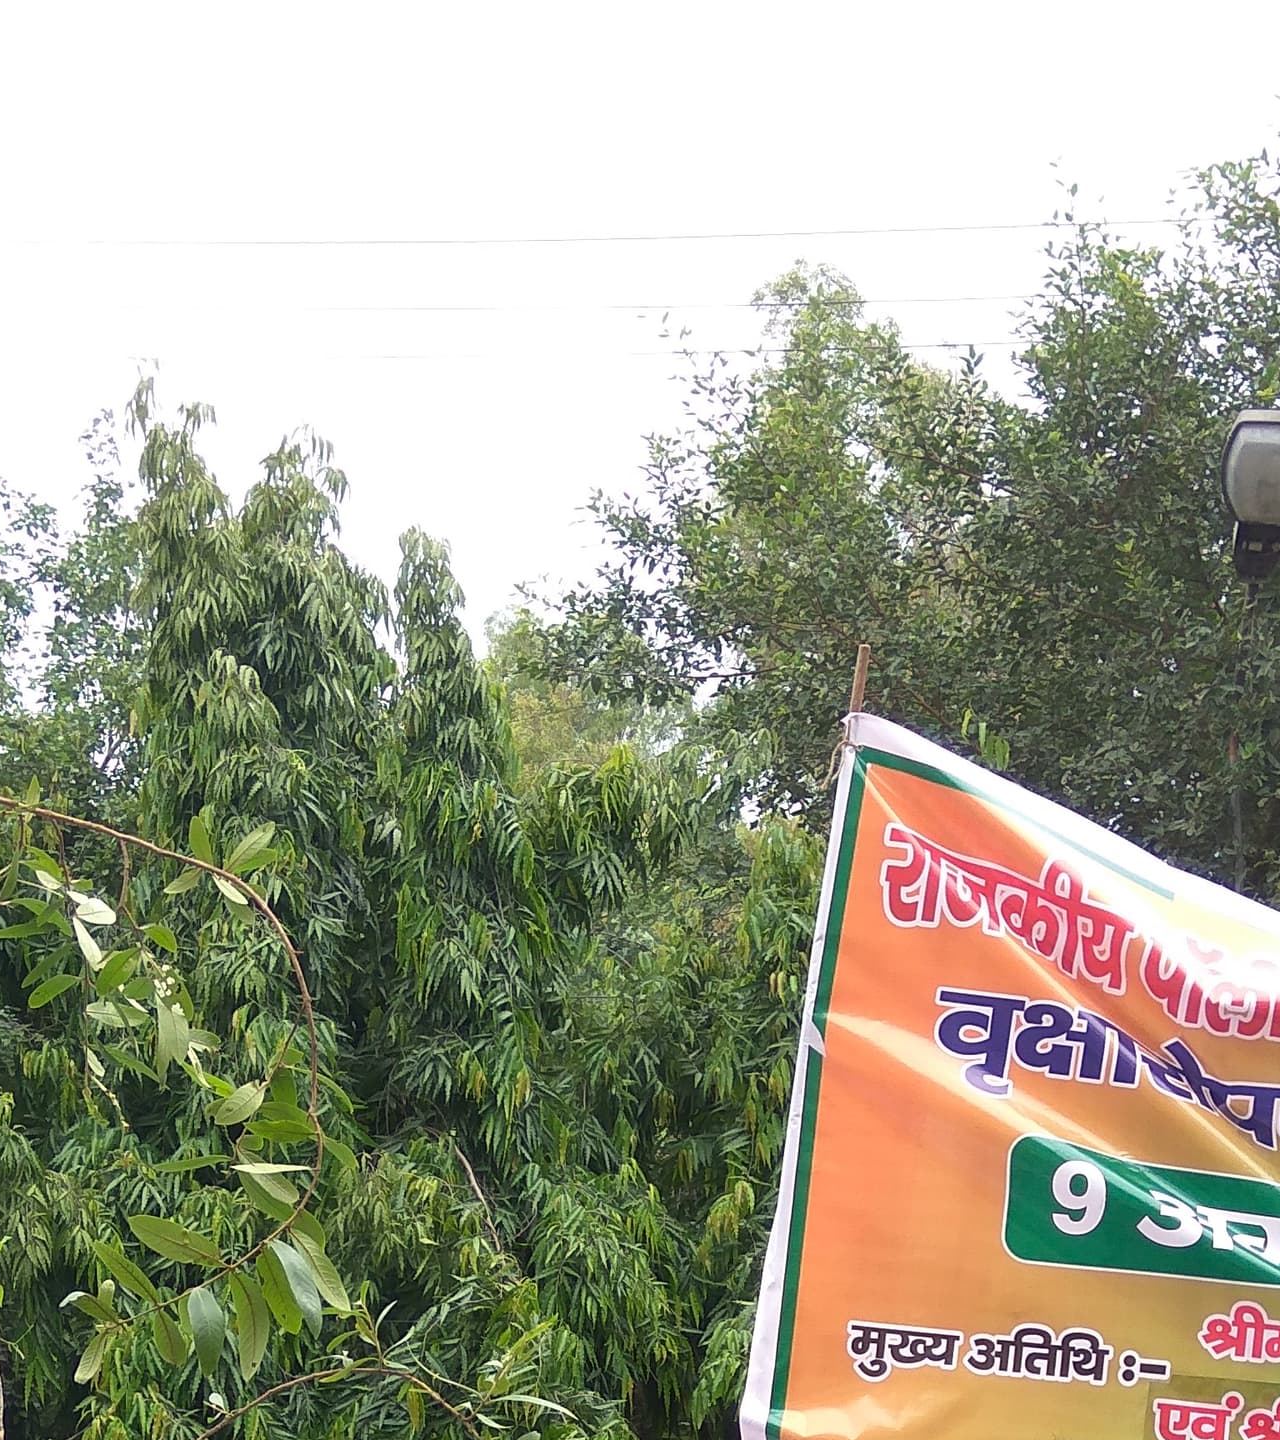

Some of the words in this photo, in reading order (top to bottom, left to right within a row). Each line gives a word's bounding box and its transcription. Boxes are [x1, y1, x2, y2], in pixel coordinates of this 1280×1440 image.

[883, 826, 1135, 992] राजकीय
[1051, 1160, 1107, 1235] 9
[850, 1323, 961, 1378] मुख्य
[967, 1326, 1110, 1382] अतिथि
